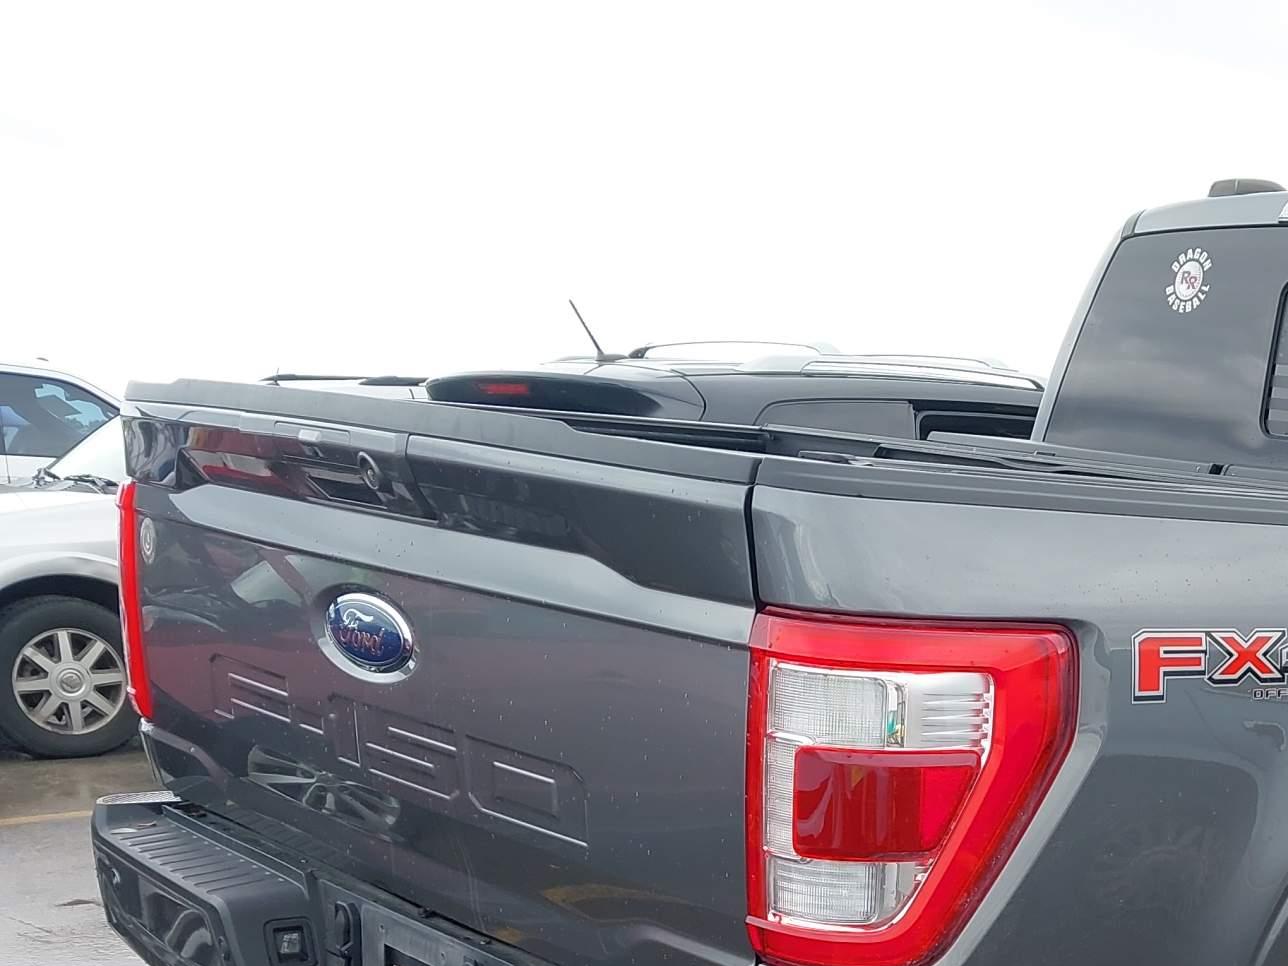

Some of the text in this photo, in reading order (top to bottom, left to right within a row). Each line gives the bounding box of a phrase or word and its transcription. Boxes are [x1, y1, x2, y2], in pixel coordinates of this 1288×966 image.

[1171, 248, 1212, 272] DRAGON
[1165, 284, 1210, 313] BASEBALL
[339, 608, 386, 656] Ford
[1253, 687, 1288, 700] OFF
[210, 653, 590, 848] F-150
